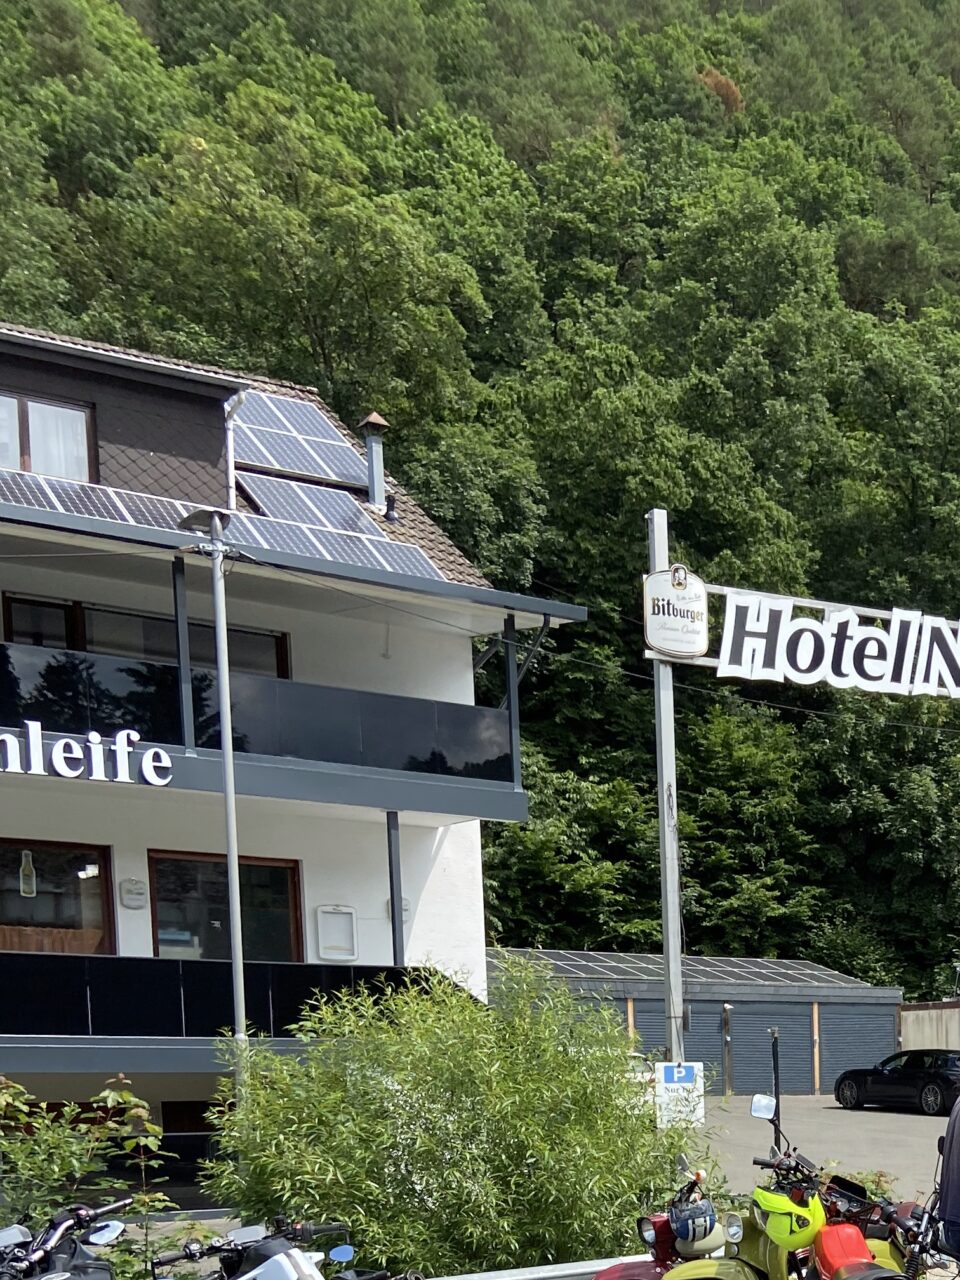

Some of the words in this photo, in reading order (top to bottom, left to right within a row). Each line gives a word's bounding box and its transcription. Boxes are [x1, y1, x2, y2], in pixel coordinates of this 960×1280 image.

[650, 597, 704, 623] Bitburger
[728, 604, 912, 684] Hotel
[673, 1067, 686, 1082] P
